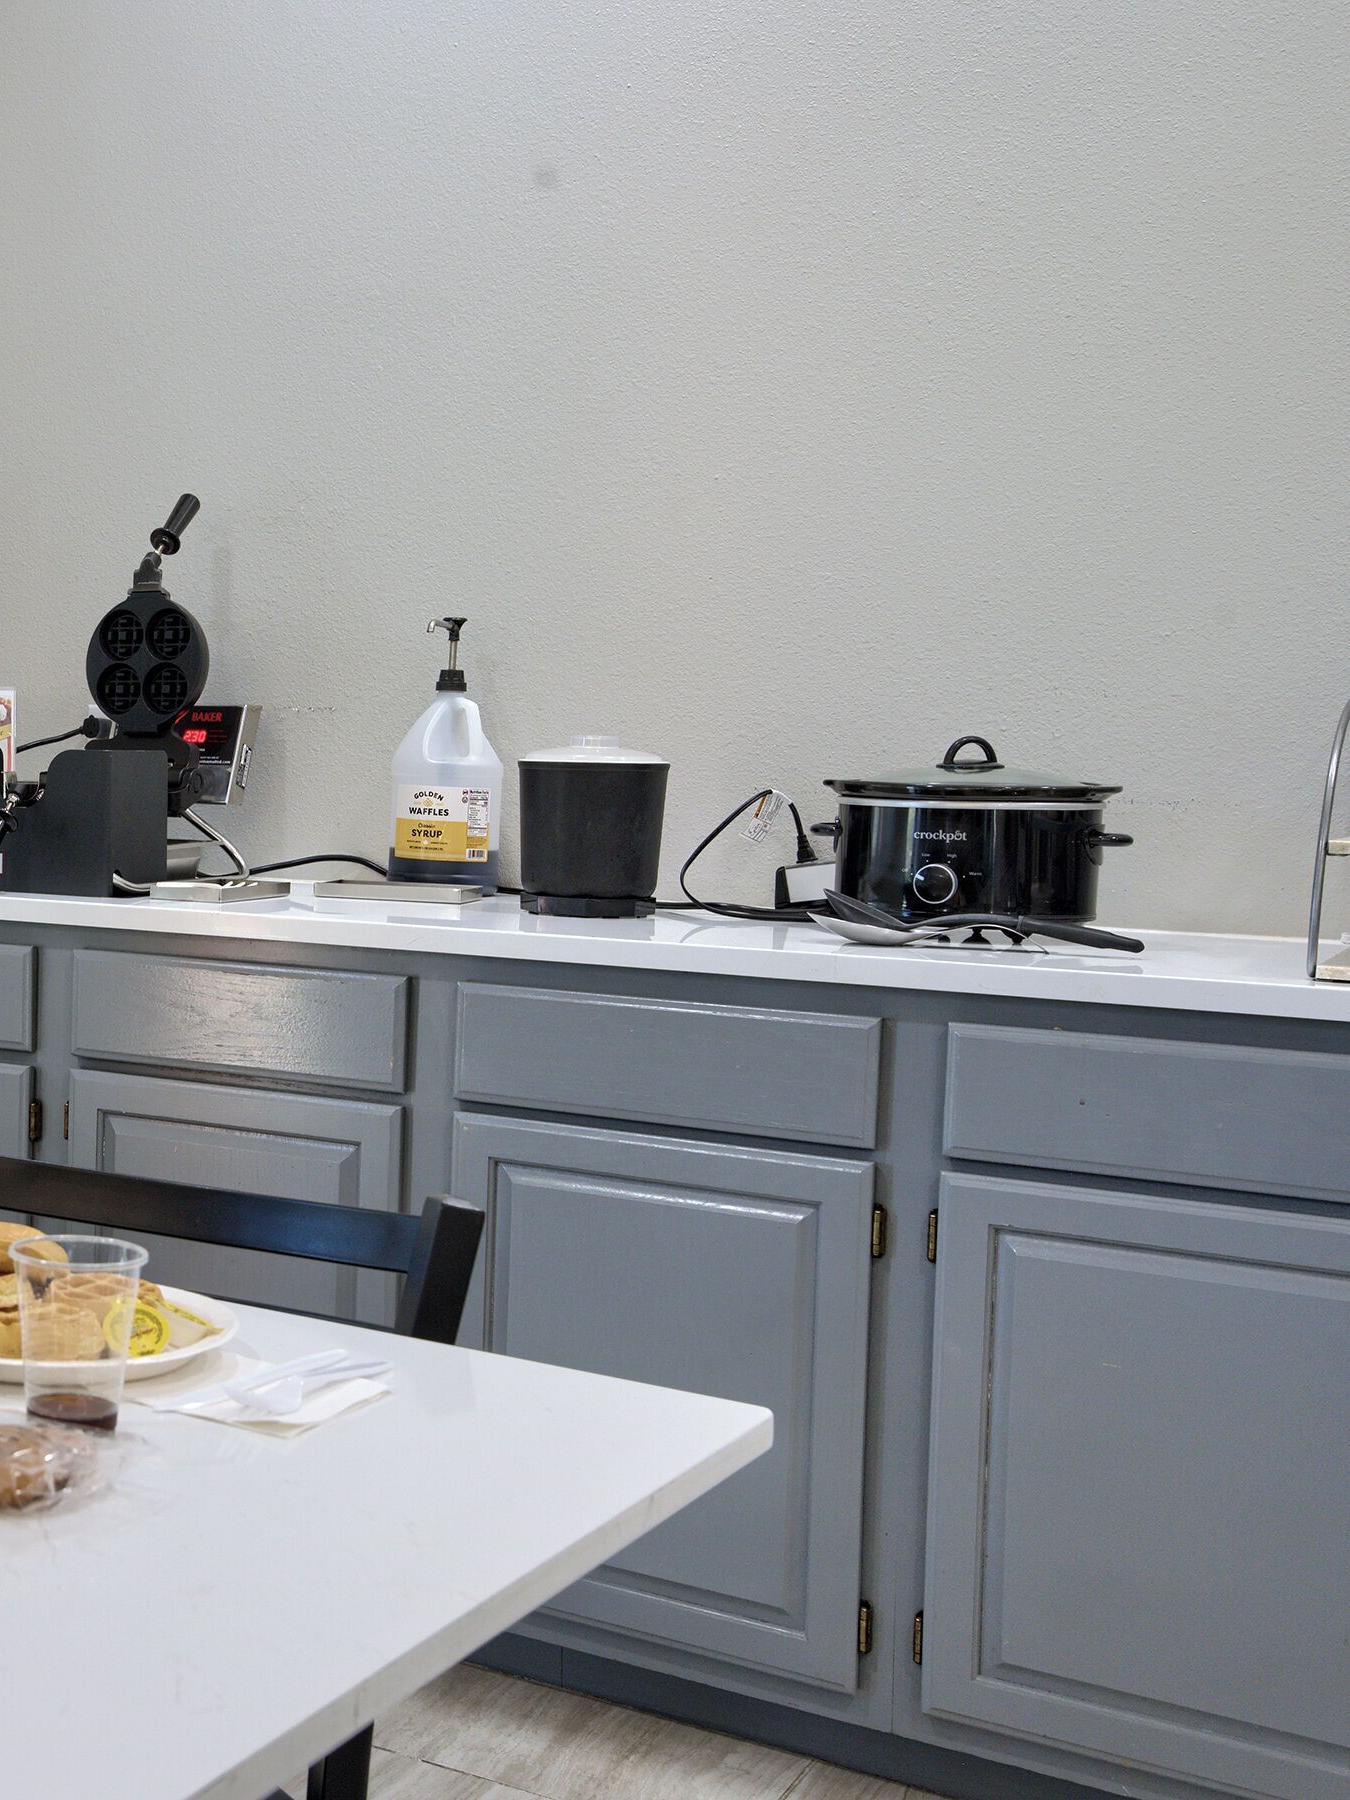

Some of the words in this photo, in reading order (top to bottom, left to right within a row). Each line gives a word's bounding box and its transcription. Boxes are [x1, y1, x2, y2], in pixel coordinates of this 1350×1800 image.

[192, 712, 222, 721] BAKER
[183, 730, 207, 743] 230
[413, 791, 444, 802] GOLDEN
[409, 807, 449, 816] WAFFLES
[412, 829, 442, 838] SYRUP
[914, 830, 967, 843] crockpot
